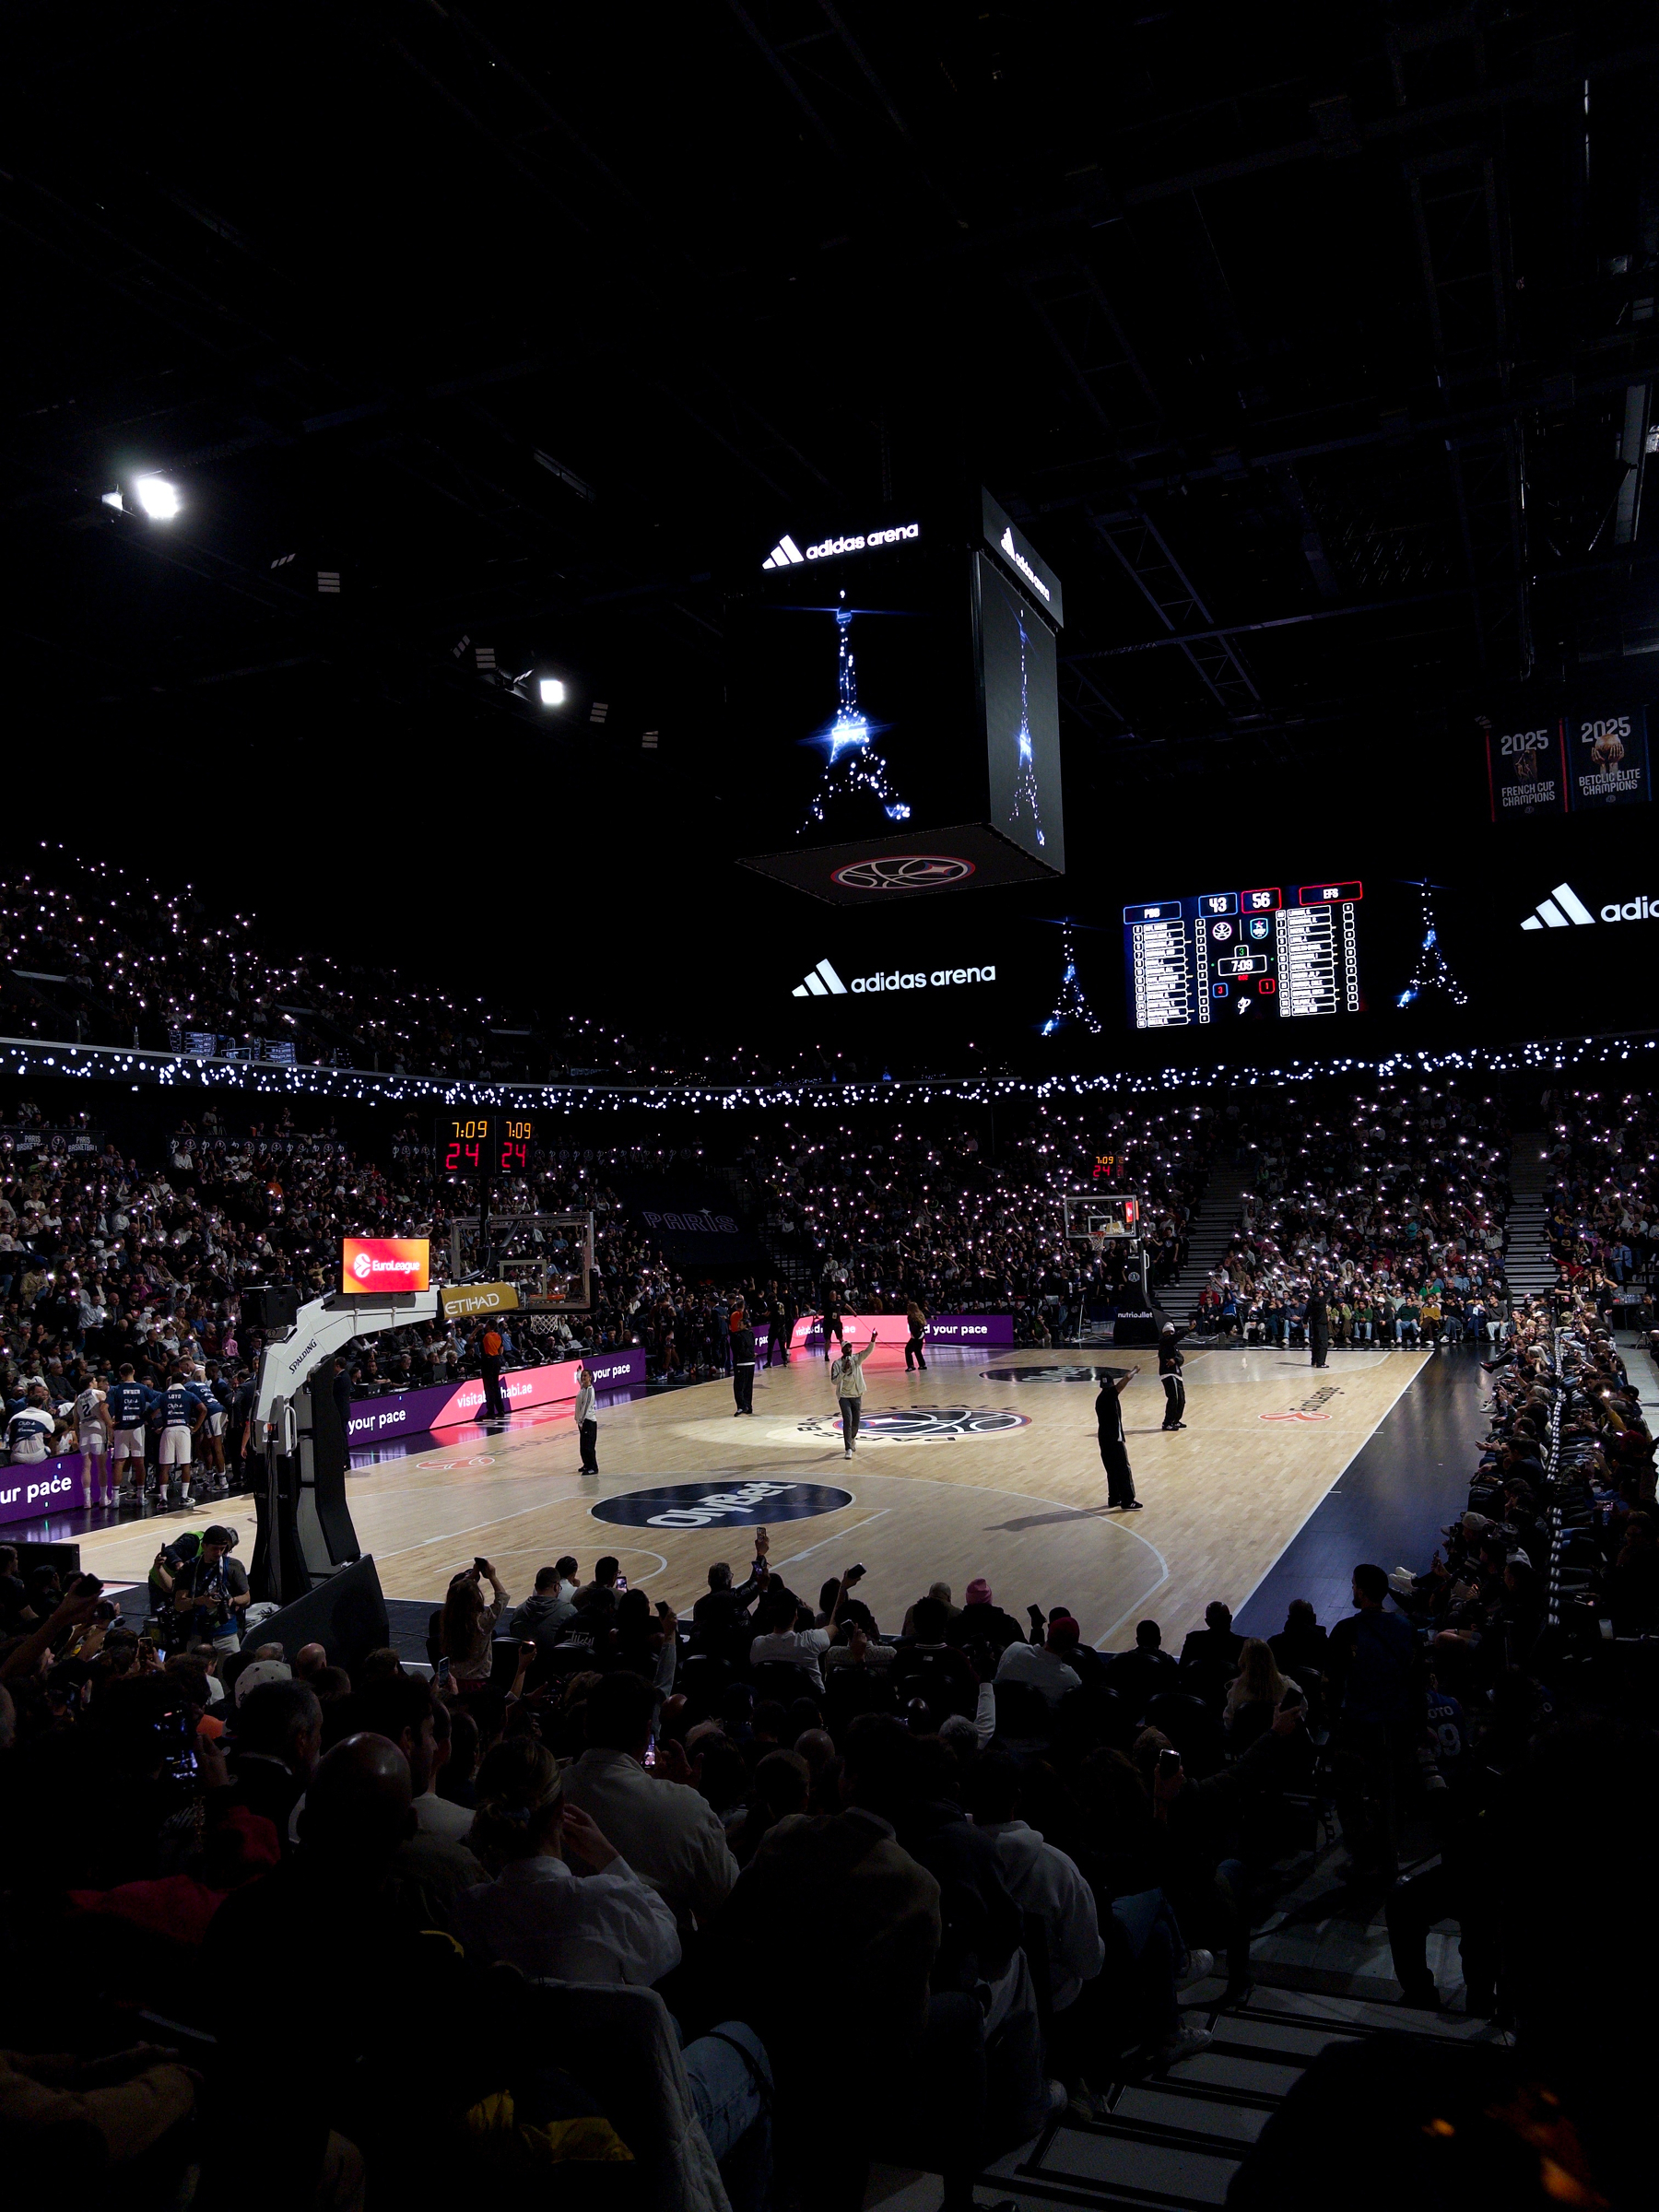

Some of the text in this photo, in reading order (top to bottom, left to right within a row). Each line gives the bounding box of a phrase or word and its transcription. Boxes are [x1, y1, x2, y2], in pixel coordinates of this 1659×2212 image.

[806, 524, 919, 559] adidas arena
[1581, 715, 1631, 743] 2025
[1500, 729, 1549, 755] 2025
[1578, 772, 1615, 787] BETCLIC
[1583, 780, 1638, 796] CHAMPIONS
[1501, 781, 1555, 798] FRENCH CUP
[1502, 791, 1556, 807] CHAMPIONS
[1252, 892, 1271, 909] 56
[1323, 888, 1339, 900] EFS
[1208, 897, 1228, 913] 43
[1239, 947, 1244, 956] 3
[1231, 959, 1253, 972] 7:09
[851, 966, 996, 994] adidas arena
[1218, 986, 1224, 994] 3
[452, 1120, 488, 1139] 7:09
[505, 1121, 532, 1140] 7:09
[24, 1135, 41, 1143] PARIS
[76, 1135, 91, 1145] PARIS
[445, 1143, 479, 1170] 24
[501, 1141, 527, 1169] 24
[1095, 1156, 1114, 1165] 7:09
[1092, 1164, 1111, 1178] 24
[641, 1206, 738, 1233] PARIS
[372, 1260, 420, 1275] EuroLeague
[445, 1292, 500, 1315] ETIHAD
[933, 1325, 959, 1336] your
[960, 1325, 988, 1336] pace
[288, 1338, 317, 1374] SPALDING
[593, 1368, 611, 1382] your
[612, 1364, 630, 1379] pace
[82, 1403, 91, 1418] 2
[347, 1408, 406, 1435] your pace
[0, 1477, 72, 1504] ur pace
[646, 1481, 797, 1527] OlyBet
